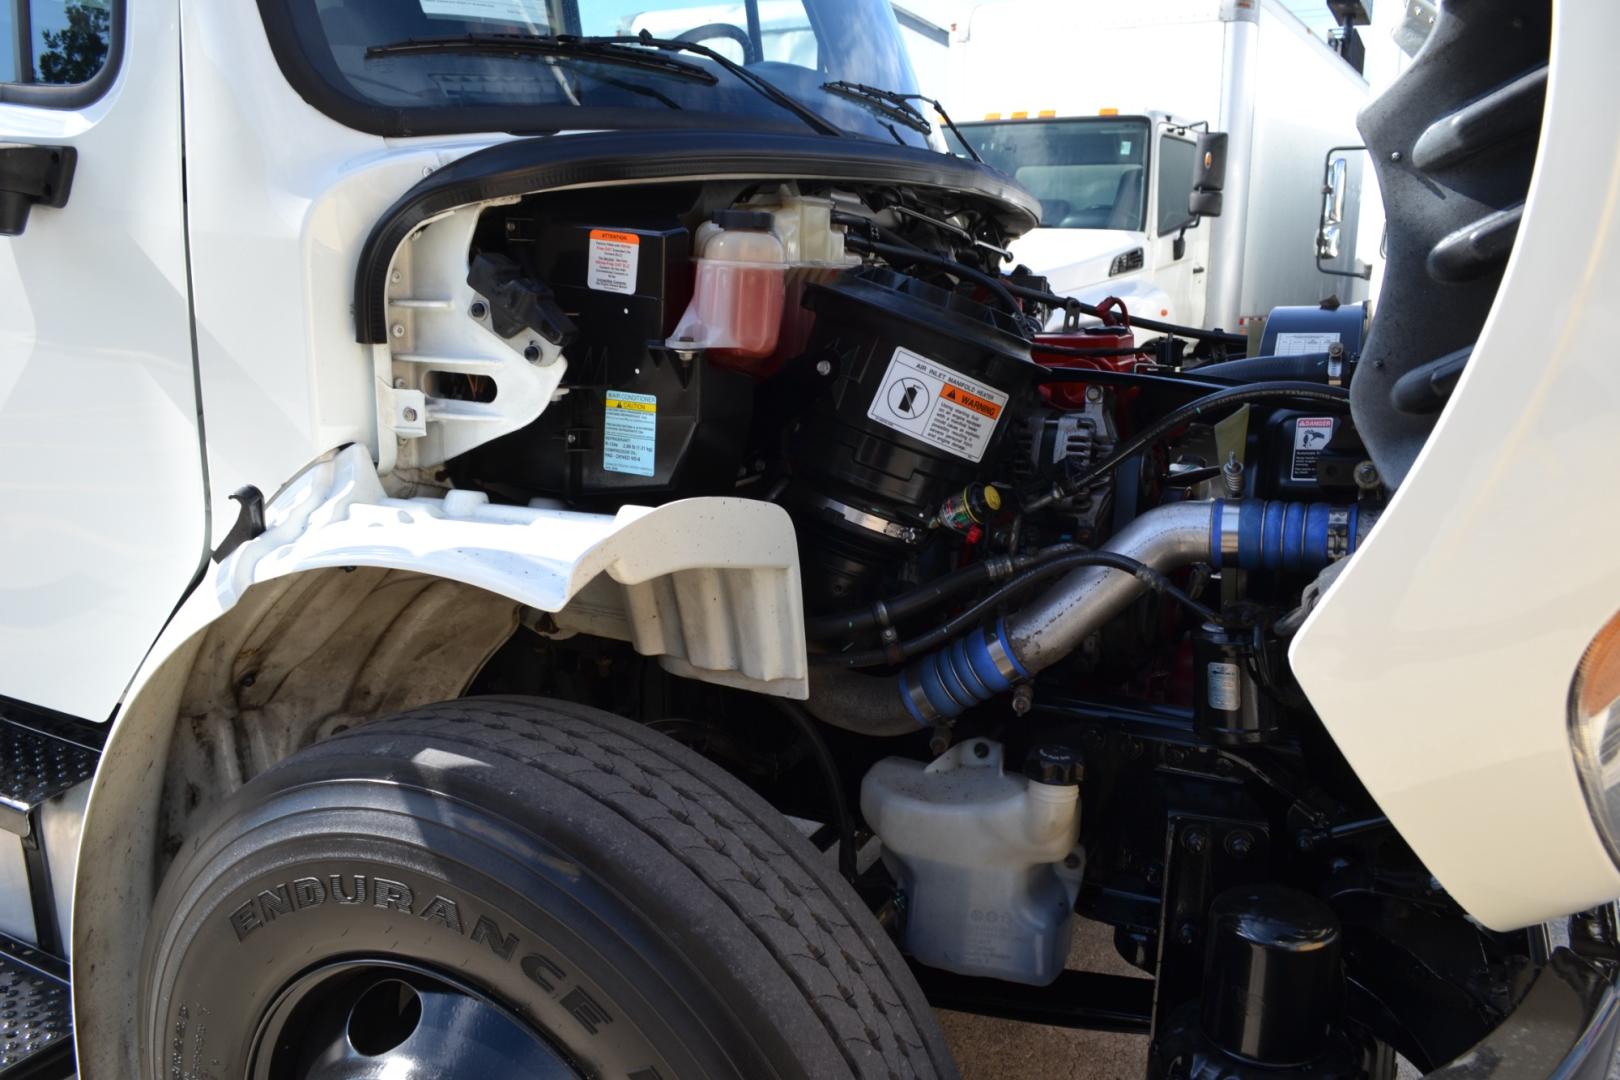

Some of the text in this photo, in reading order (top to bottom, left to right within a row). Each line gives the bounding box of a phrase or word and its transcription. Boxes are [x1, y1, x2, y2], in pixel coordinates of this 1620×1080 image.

[916, 363, 995, 401] AIR INLET MANIFOLD HEATER
[624, 402, 646, 410] CAUTION
[960, 395, 996, 416] WARNING
[228, 874, 613, 1036] ENDURANCE
